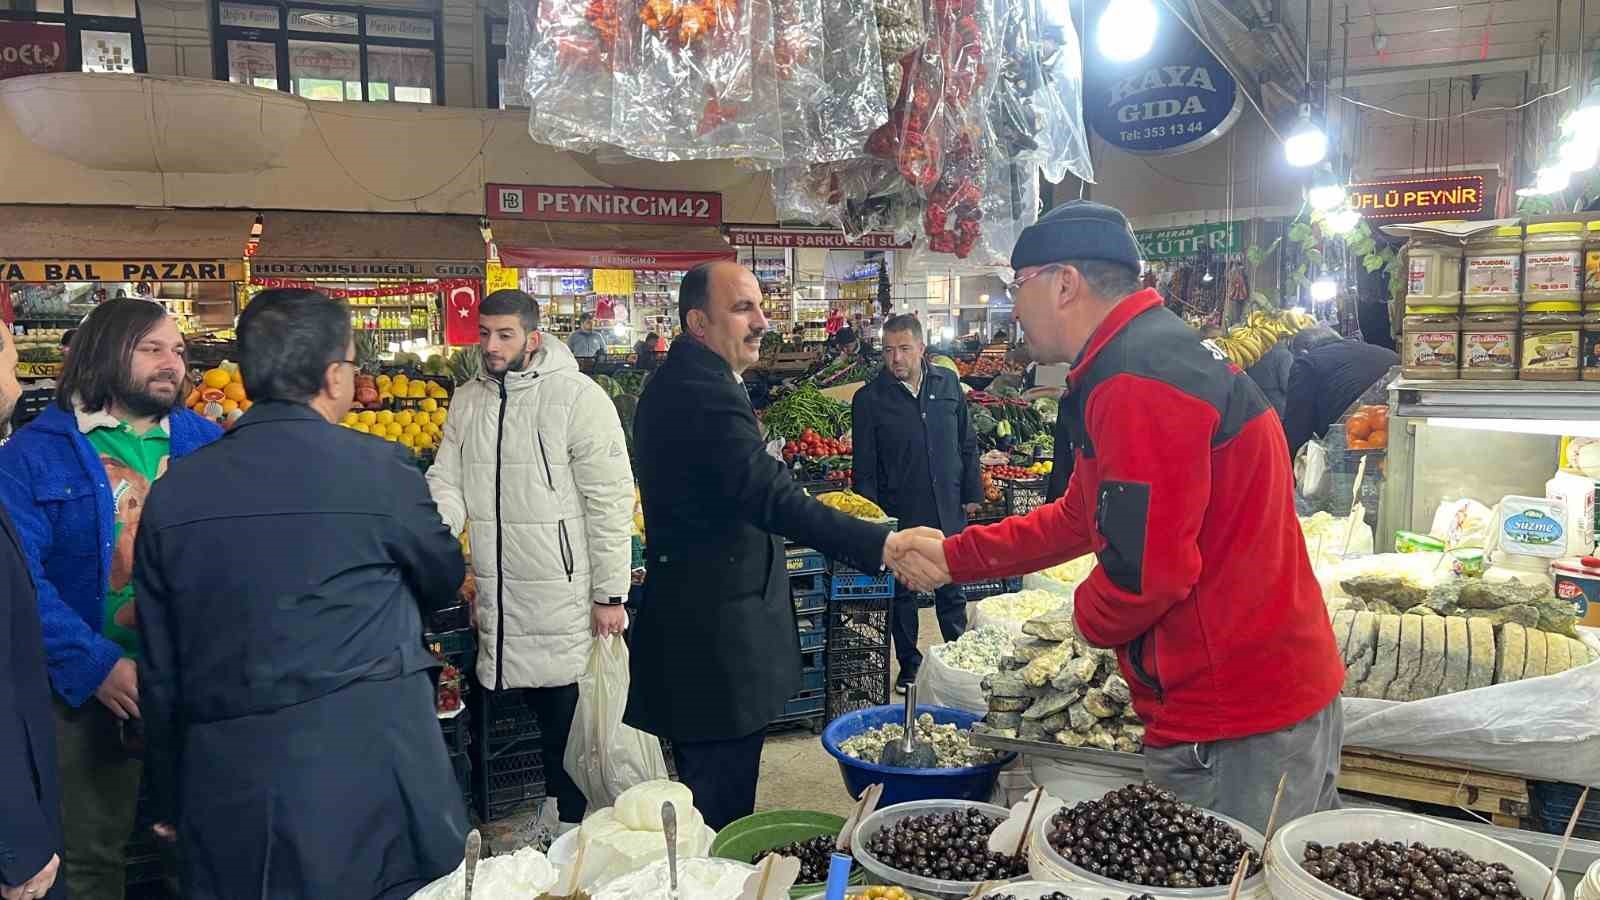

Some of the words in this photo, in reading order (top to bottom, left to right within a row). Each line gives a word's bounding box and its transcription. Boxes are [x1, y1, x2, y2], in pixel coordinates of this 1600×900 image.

[1108, 66, 1216, 107] KAYA
[1118, 96, 1206, 122] GIDA
[1120, 130, 1141, 141] Tel:
[1143, 126, 1166, 138] 353
[1170, 124, 1184, 135] 13
[1187, 121, 1202, 132] 44
[1404, 186, 1477, 207] PEYNİR
[45, 264, 100, 280] BAL
[123, 264, 226, 279] PAZARI
